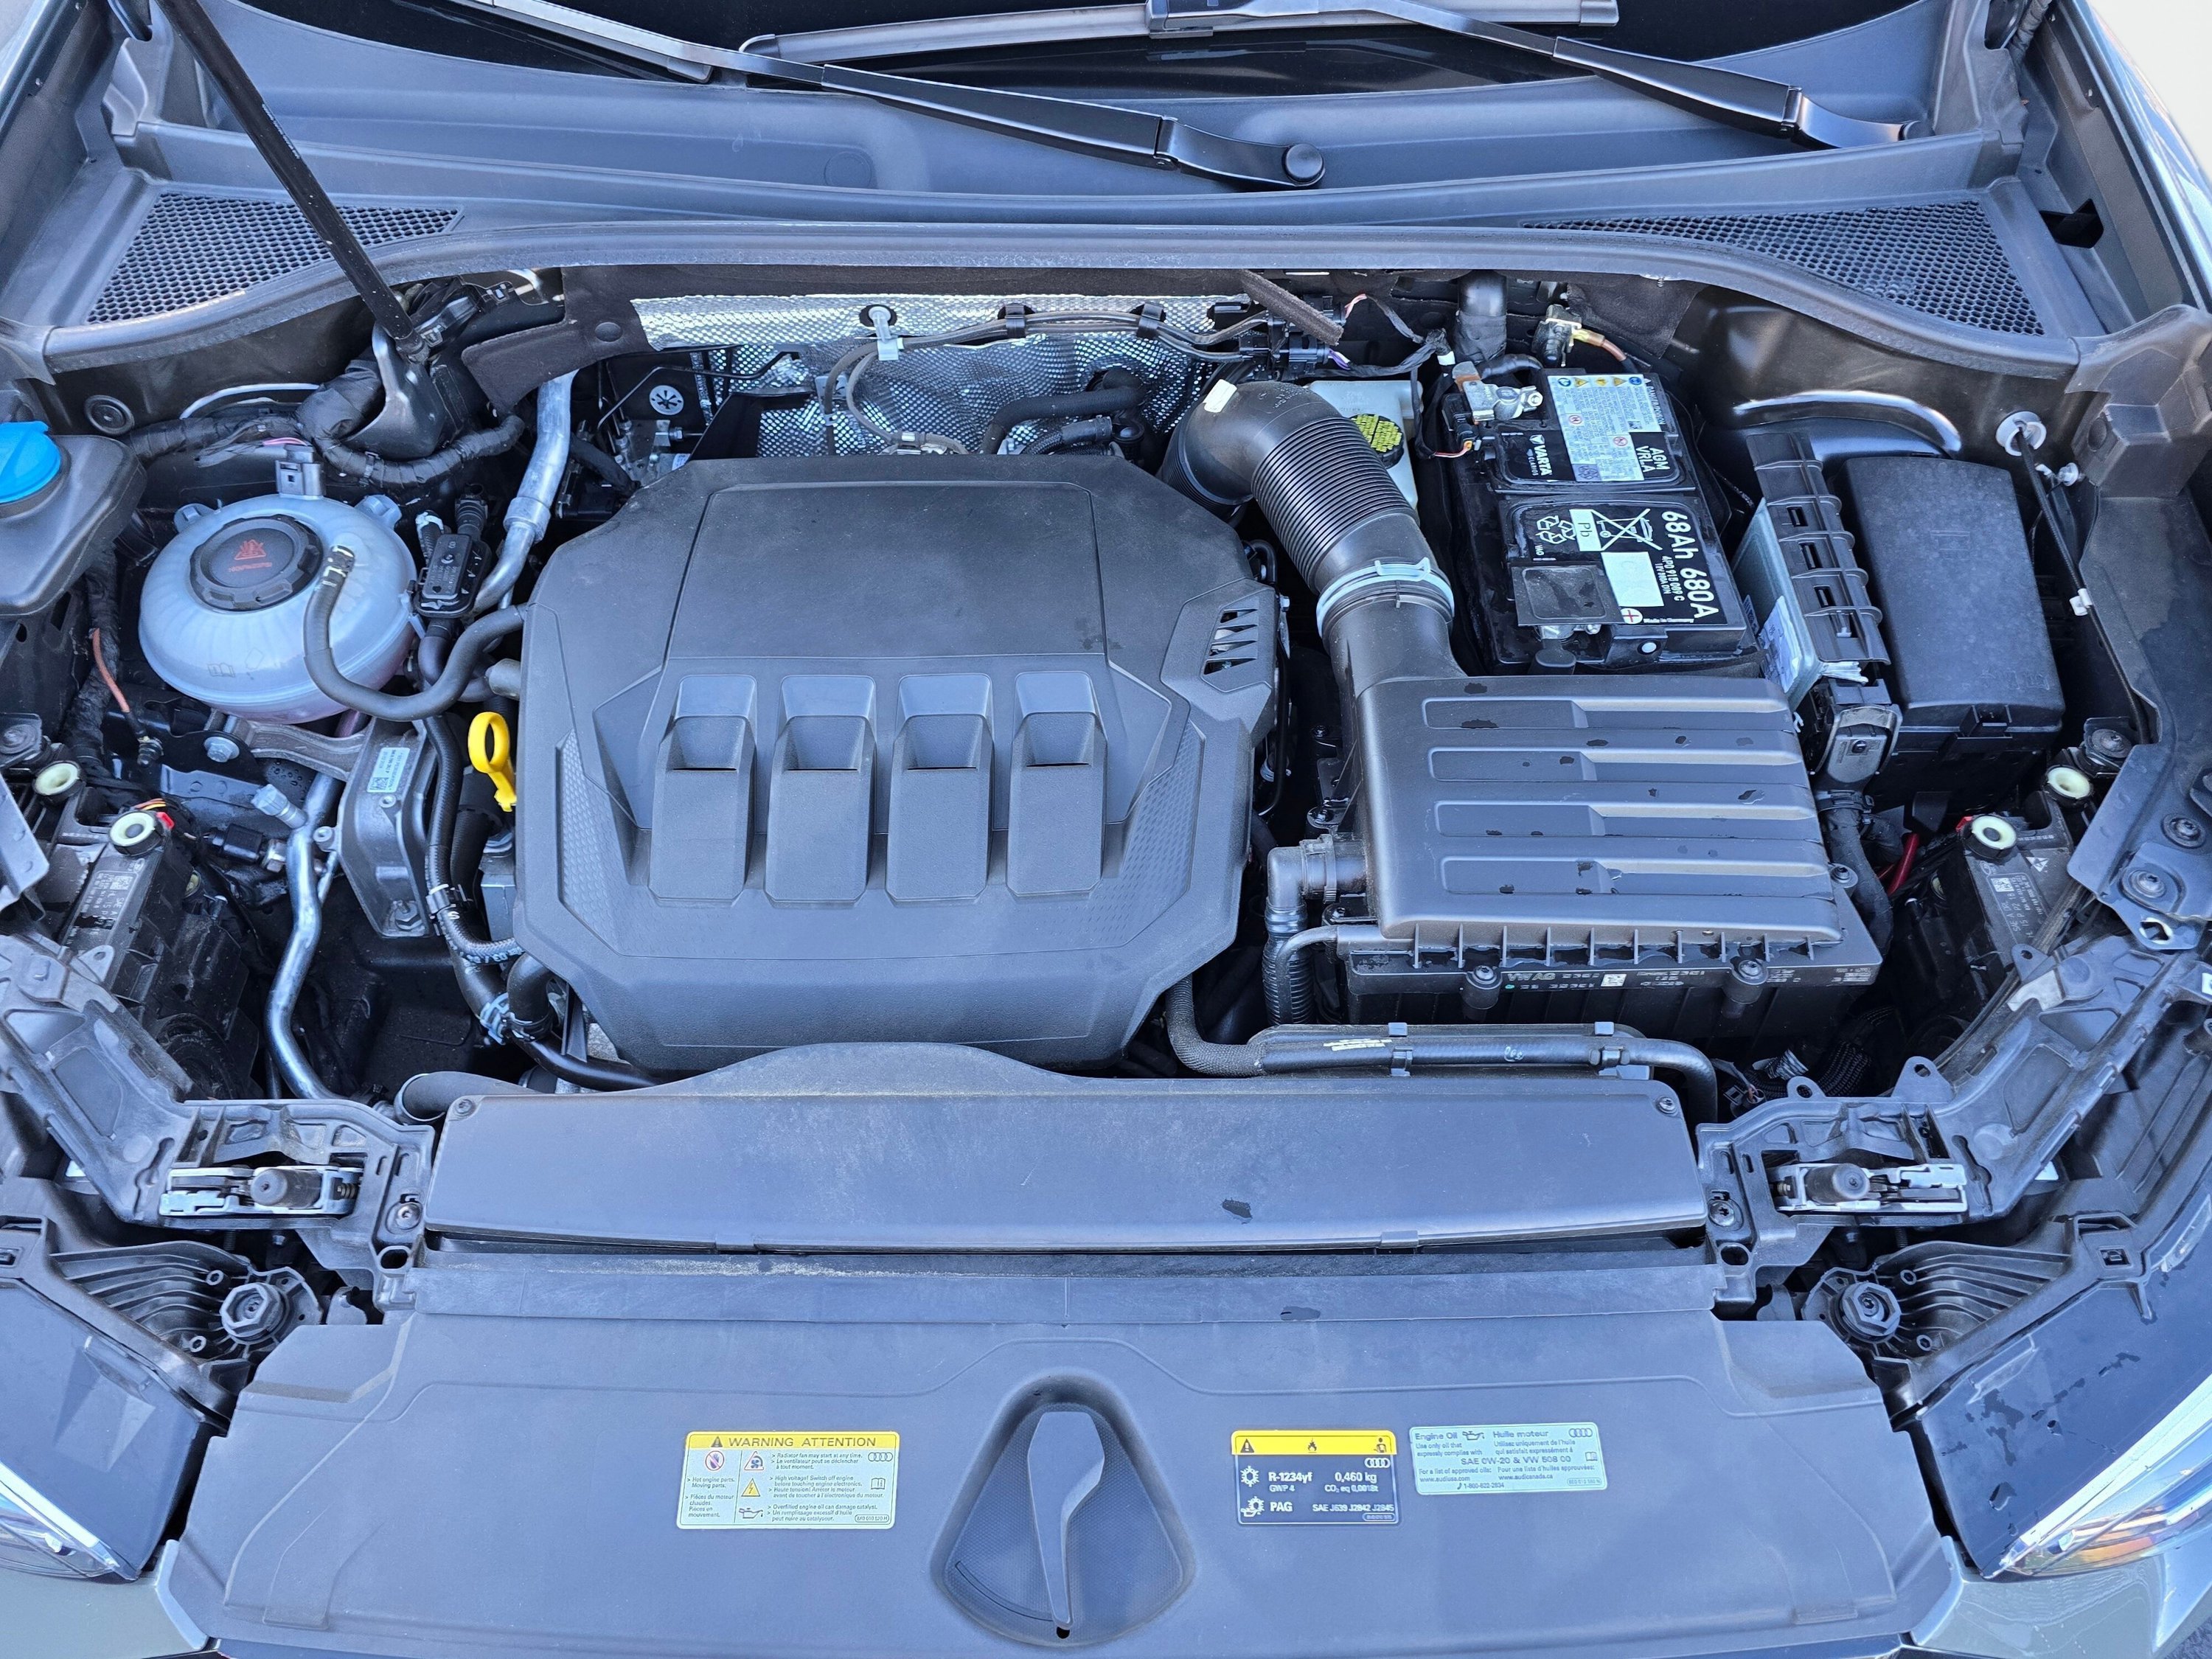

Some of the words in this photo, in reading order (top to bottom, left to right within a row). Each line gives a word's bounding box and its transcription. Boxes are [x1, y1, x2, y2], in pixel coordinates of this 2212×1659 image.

[1528, 456, 1539, 476] CLARIOS
[1534, 445, 1549, 476] VARTA
[1635, 445, 1656, 473] VRLA
[1649, 447, 1670, 470] AGM
[1578, 522, 1591, 538] Pb
[1661, 511, 1699, 559] 68Ah
[1680, 568, 1719, 618] 680A
[728, 1438, 793, 1447] WARNING
[801, 1438, 876, 1447] ATTENTION
[1268, 1472, 1312, 1484] R-1234yf
[1335, 1472, 1363, 1483] 0,460
[1365, 1472, 1377, 1484] kg
[1270, 1502, 1293, 1512] PAG
